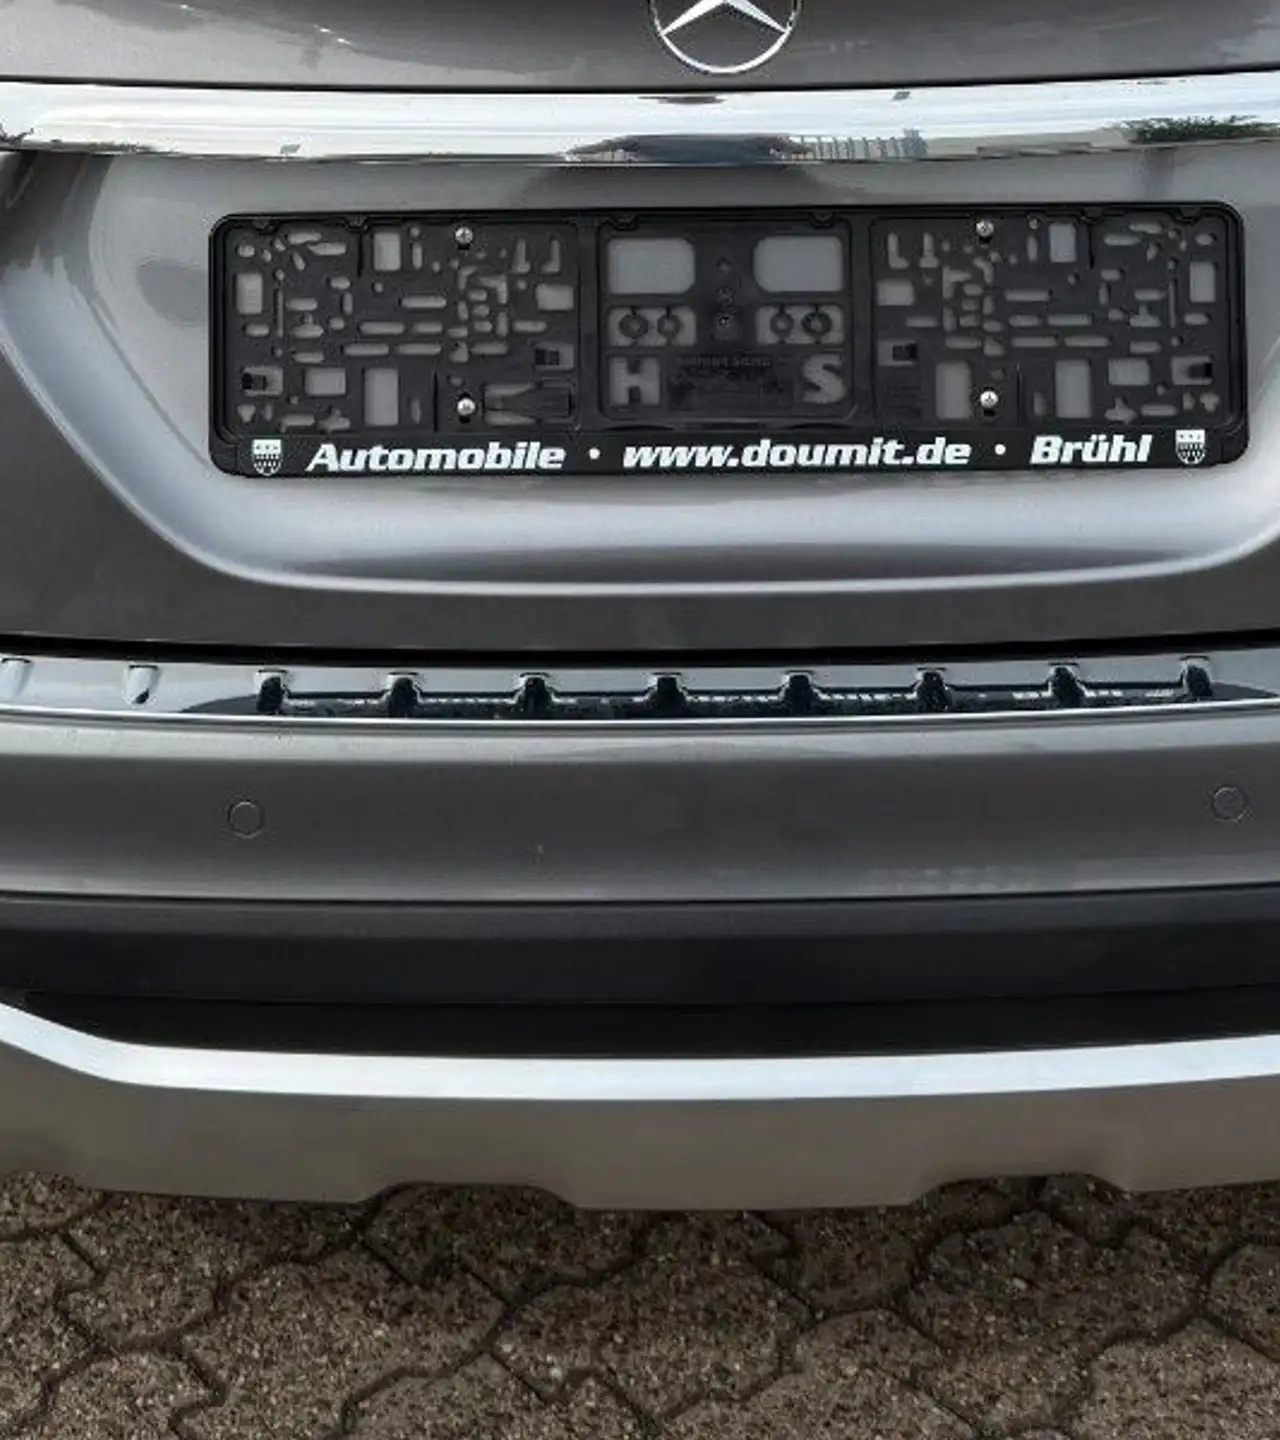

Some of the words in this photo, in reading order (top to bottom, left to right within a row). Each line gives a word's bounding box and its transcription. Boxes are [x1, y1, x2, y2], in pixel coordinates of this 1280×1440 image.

[305, 442, 566, 472] Automobile
[622, 436, 972, 469] www.doumit.de
[1029, 434, 1153, 465] Brühl
